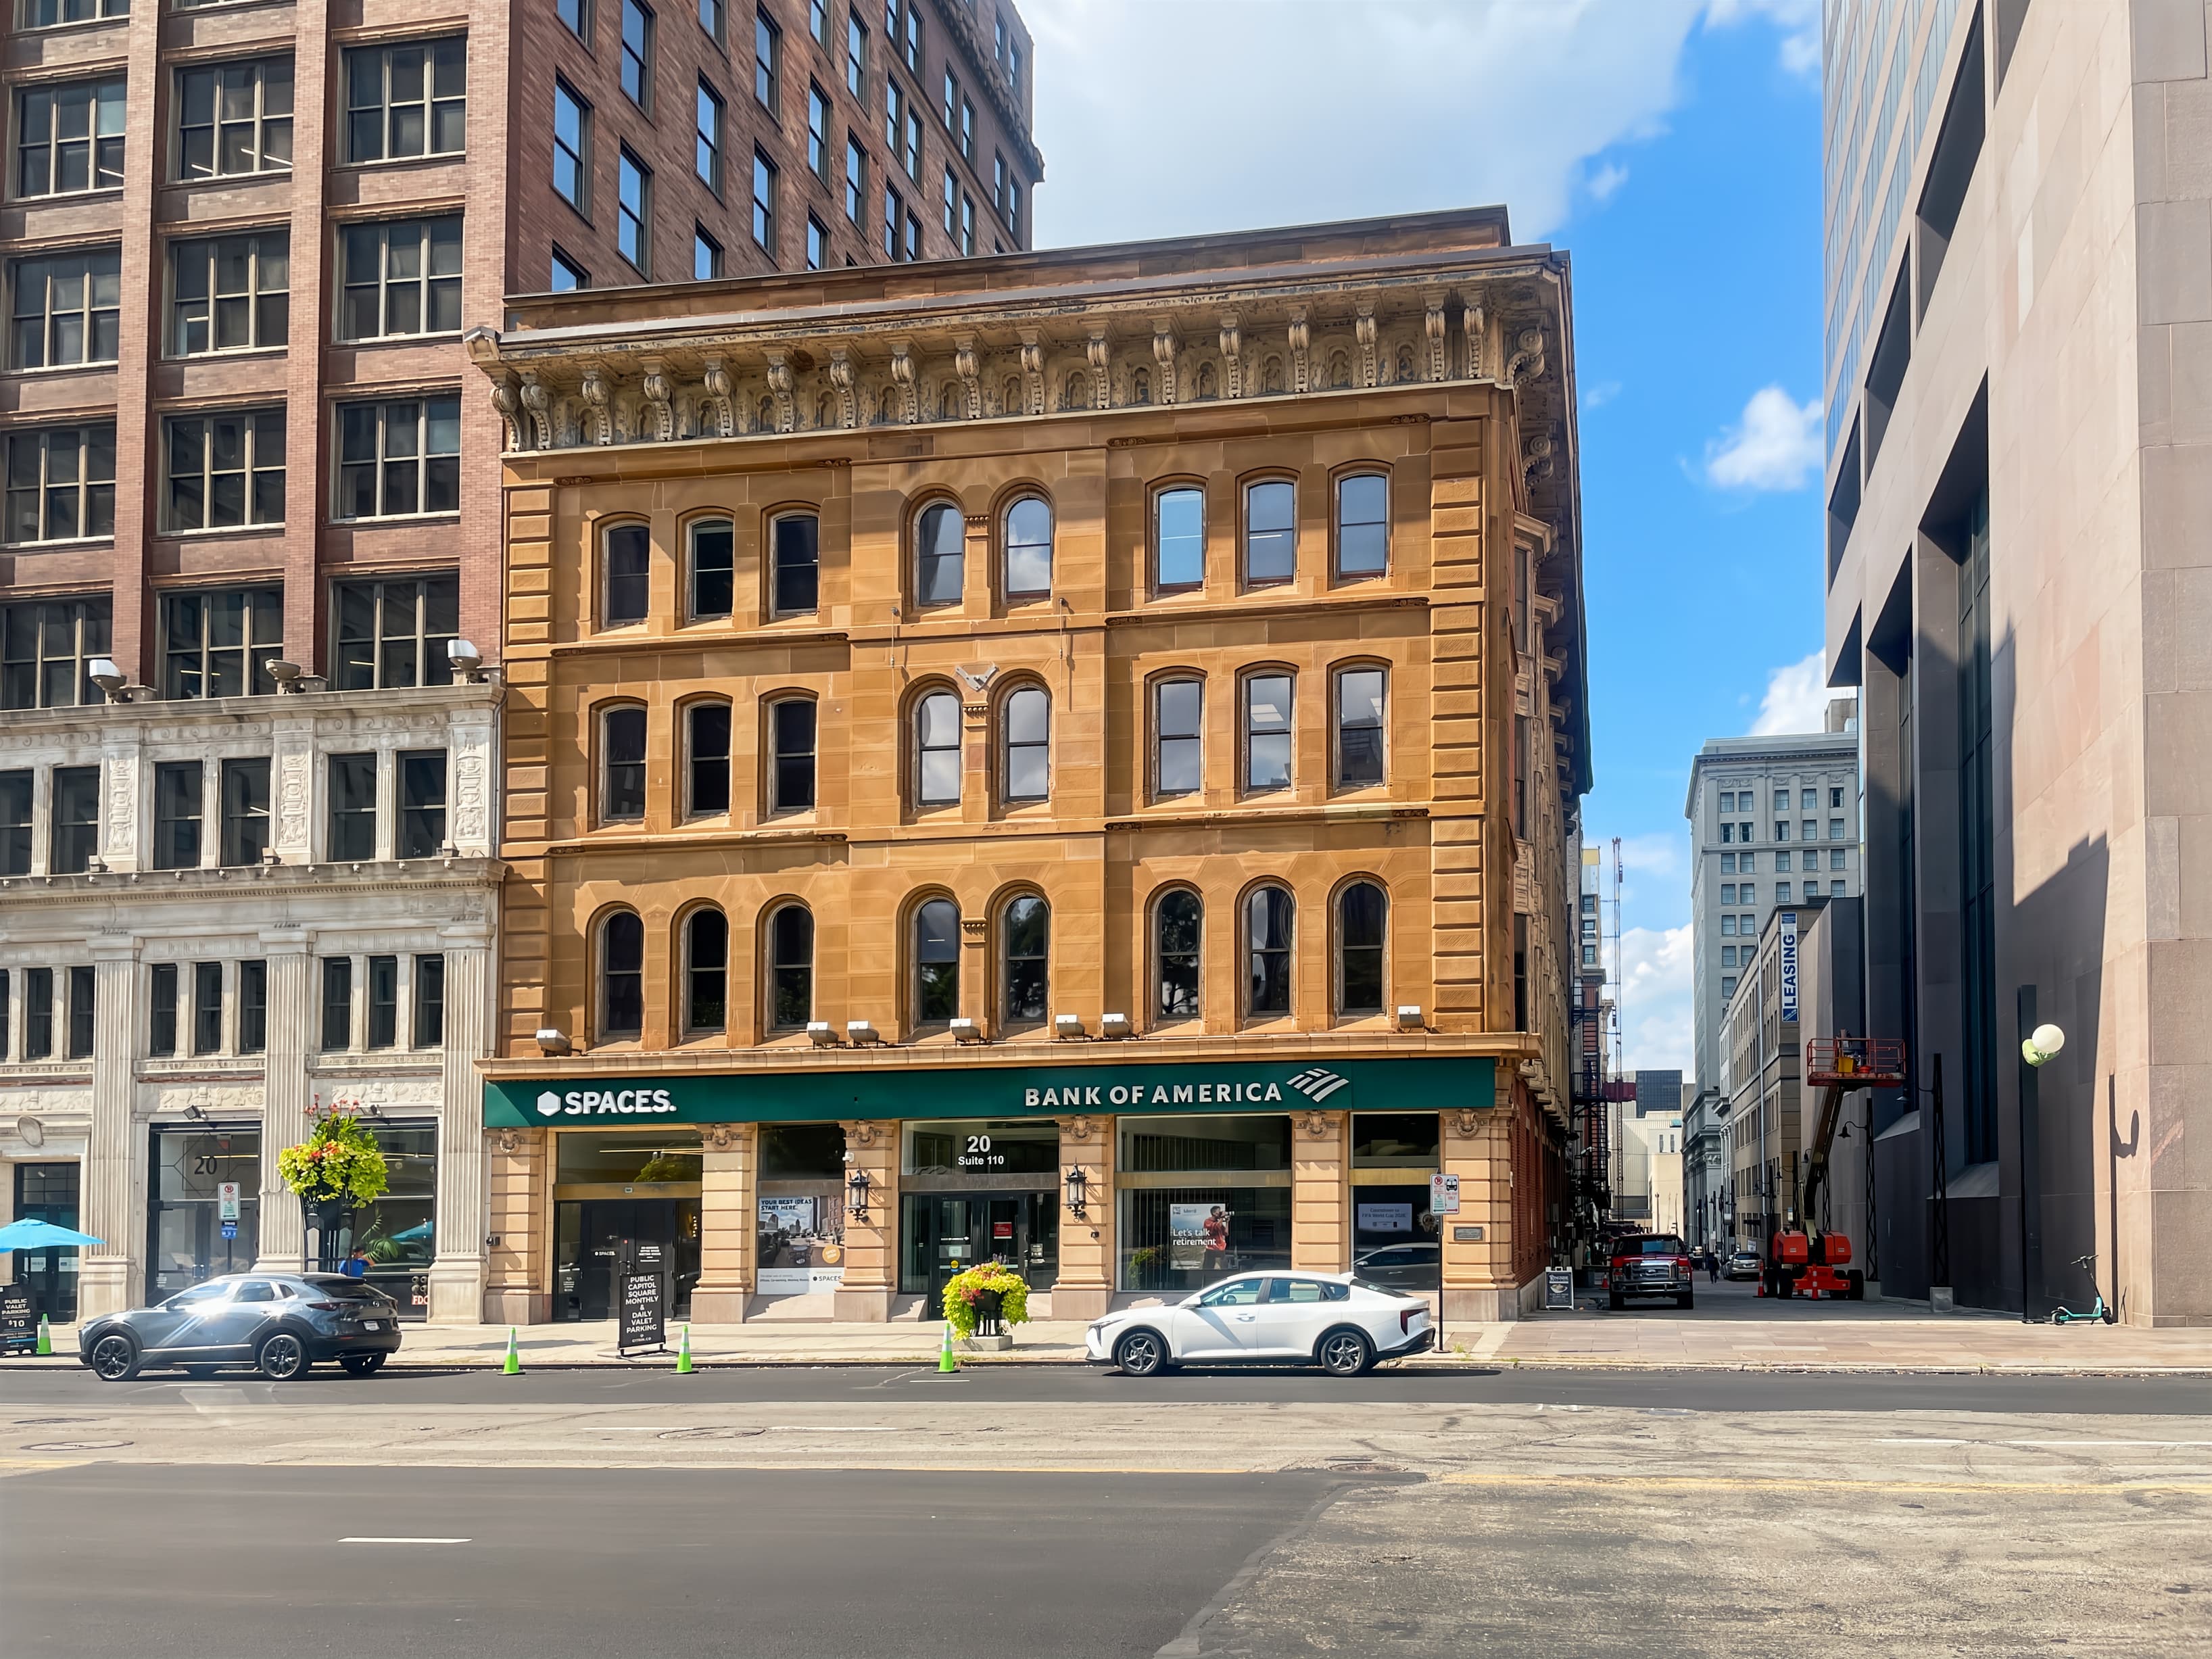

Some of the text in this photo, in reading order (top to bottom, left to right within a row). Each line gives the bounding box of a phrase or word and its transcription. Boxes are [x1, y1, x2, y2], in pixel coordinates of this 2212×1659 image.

[1783, 934, 1796, 1007] LEASING
[1025, 1082, 1282, 1107] BANK OF AMERICA
[564, 1089, 677, 1115] SPACES.
[967, 1135, 991, 1153] 20
[958, 1155, 1005, 1165] Suite 110
[194, 1156, 217, 1175] 20
[630, 1275, 654, 1283] PUBLIC
[628, 1282, 656, 1291] CAPITOL
[628, 1289, 656, 1297] SQUARE
[625, 1295, 659, 1305] MONTHLY
[632, 1310, 652, 1318] DAILY
[631, 1317, 652, 1326] VALET
[626, 1324, 657, 1334] PARKING
